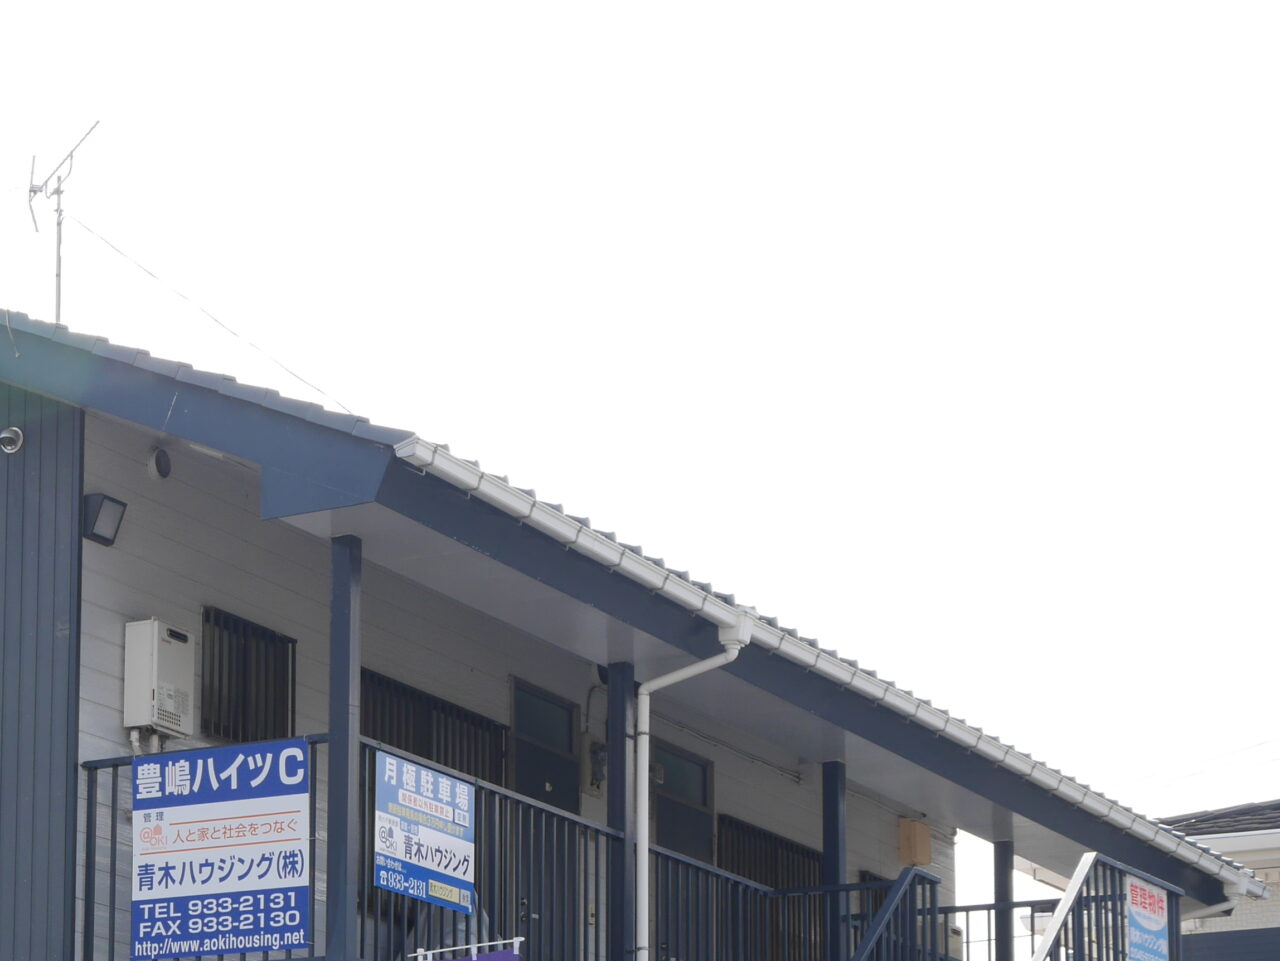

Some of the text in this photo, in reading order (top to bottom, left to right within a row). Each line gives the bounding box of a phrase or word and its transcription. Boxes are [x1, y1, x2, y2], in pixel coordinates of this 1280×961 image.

[136, 748, 304, 799] 豊嶋ハイツC
[384, 757, 468, 811] 月極駐車場
[144, 812, 164, 822] 管理
[172, 818, 298, 844] 人と家と社会をつなぐ
[137, 849, 304, 891] 青木ハウジング(株)
[404, 834, 470, 876] 青木ハウジング
[140, 891, 296, 919] TEL 933-2131
[1130, 882, 1165, 918] 管理物件
[139, 910, 300, 938] FAX 933-2130
[135, 929, 304, 959] http://www.aokihousing.net
